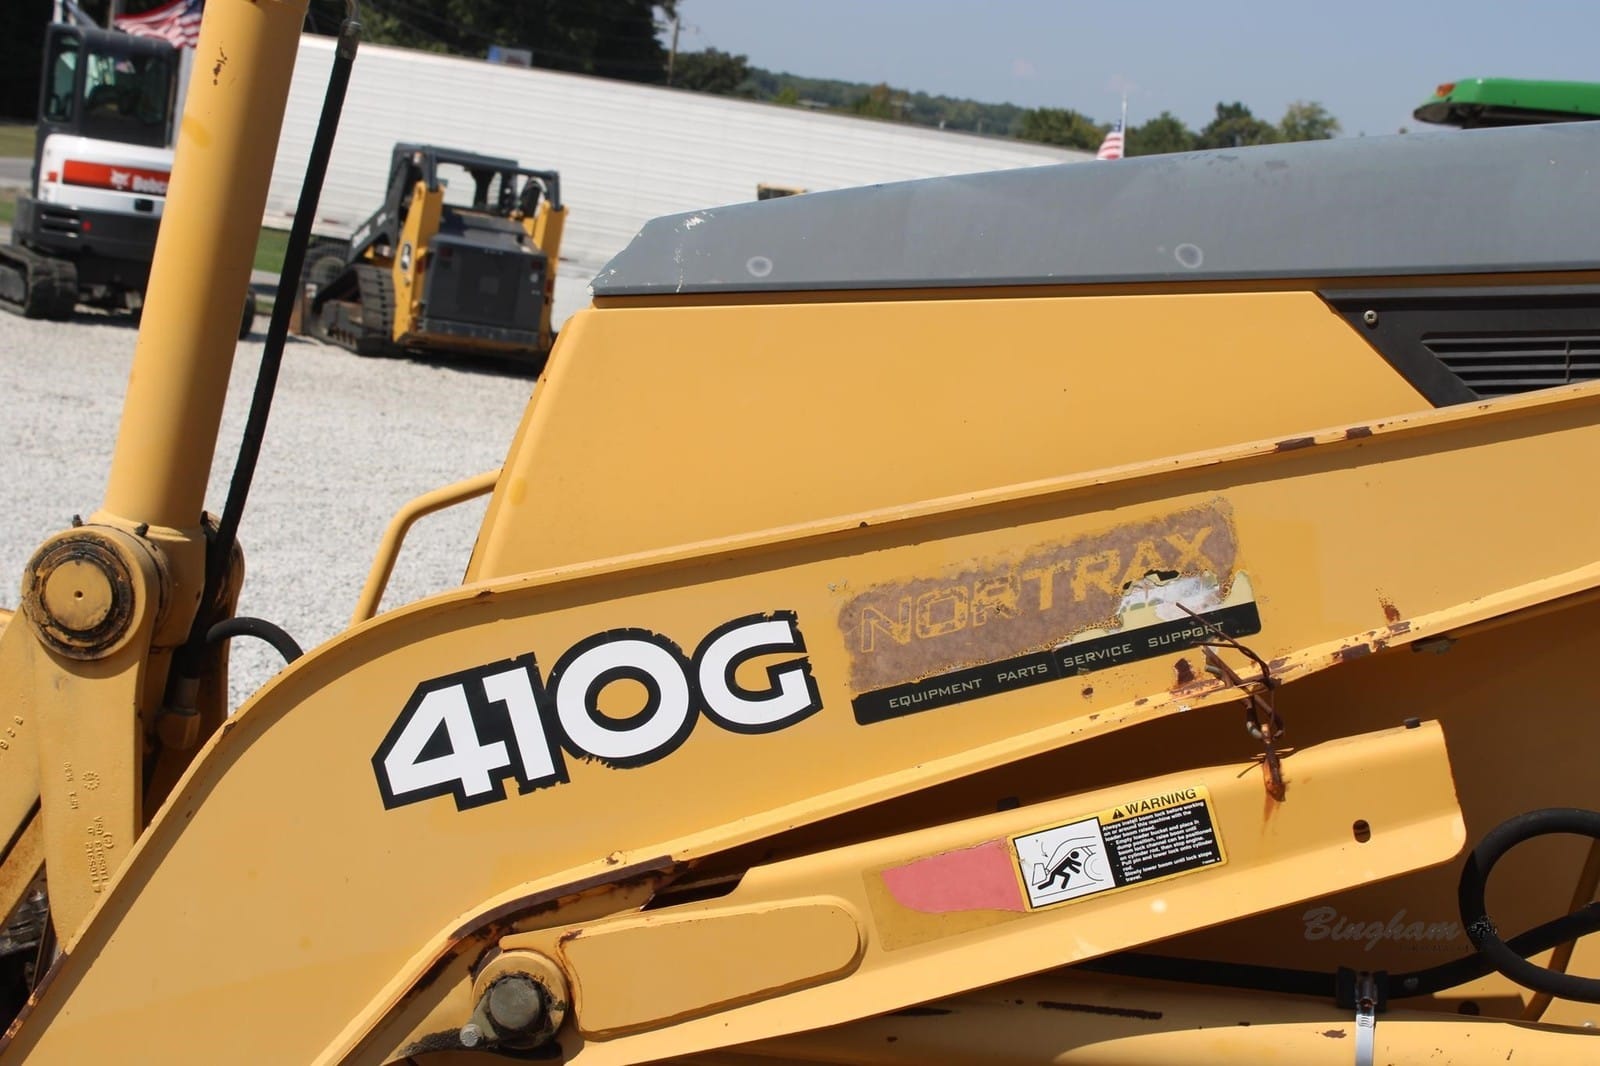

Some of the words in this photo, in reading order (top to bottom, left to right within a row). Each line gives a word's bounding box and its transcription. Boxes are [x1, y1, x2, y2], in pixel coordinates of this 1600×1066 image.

[861, 526, 1220, 654] NORTRAX
[889, 677, 983, 709] EQUIPMENT
[997, 662, 1048, 684] PARTS
[1063, 643, 1134, 668] SERVICE
[376, 613, 819, 805] 410G
[1125, 788, 1197, 815] WARNING
[1102, 822, 1121, 831] Always
[1121, 818, 1137, 826] install
[1138, 814, 1153, 822] boom
[1166, 807, 1182, 815] before
[1183, 801, 1204, 810] working
[1118, 824, 1137, 832] around
[1148, 815, 1170, 824] machine
[1105, 833, 1121, 841] loader
[1122, 829, 1137, 837] boom
[1115, 836, 1132, 844] Empty
[1133, 832, 1149, 840] loader
[1150, 827, 1168, 835] bucket
[1116, 842, 1132, 850] dump
[1169, 829, 1184, 837] boom
[1127, 850, 1148, 858] cylinder
[1152, 850, 1167, 858] lower
[1192, 839, 1212, 848] cylinder
[1124, 868, 1141, 876] Slowly
[1142, 864, 1157, 872] lower
[1157, 860, 1173, 868] boom
[1197, 850, 1212, 858] stops
